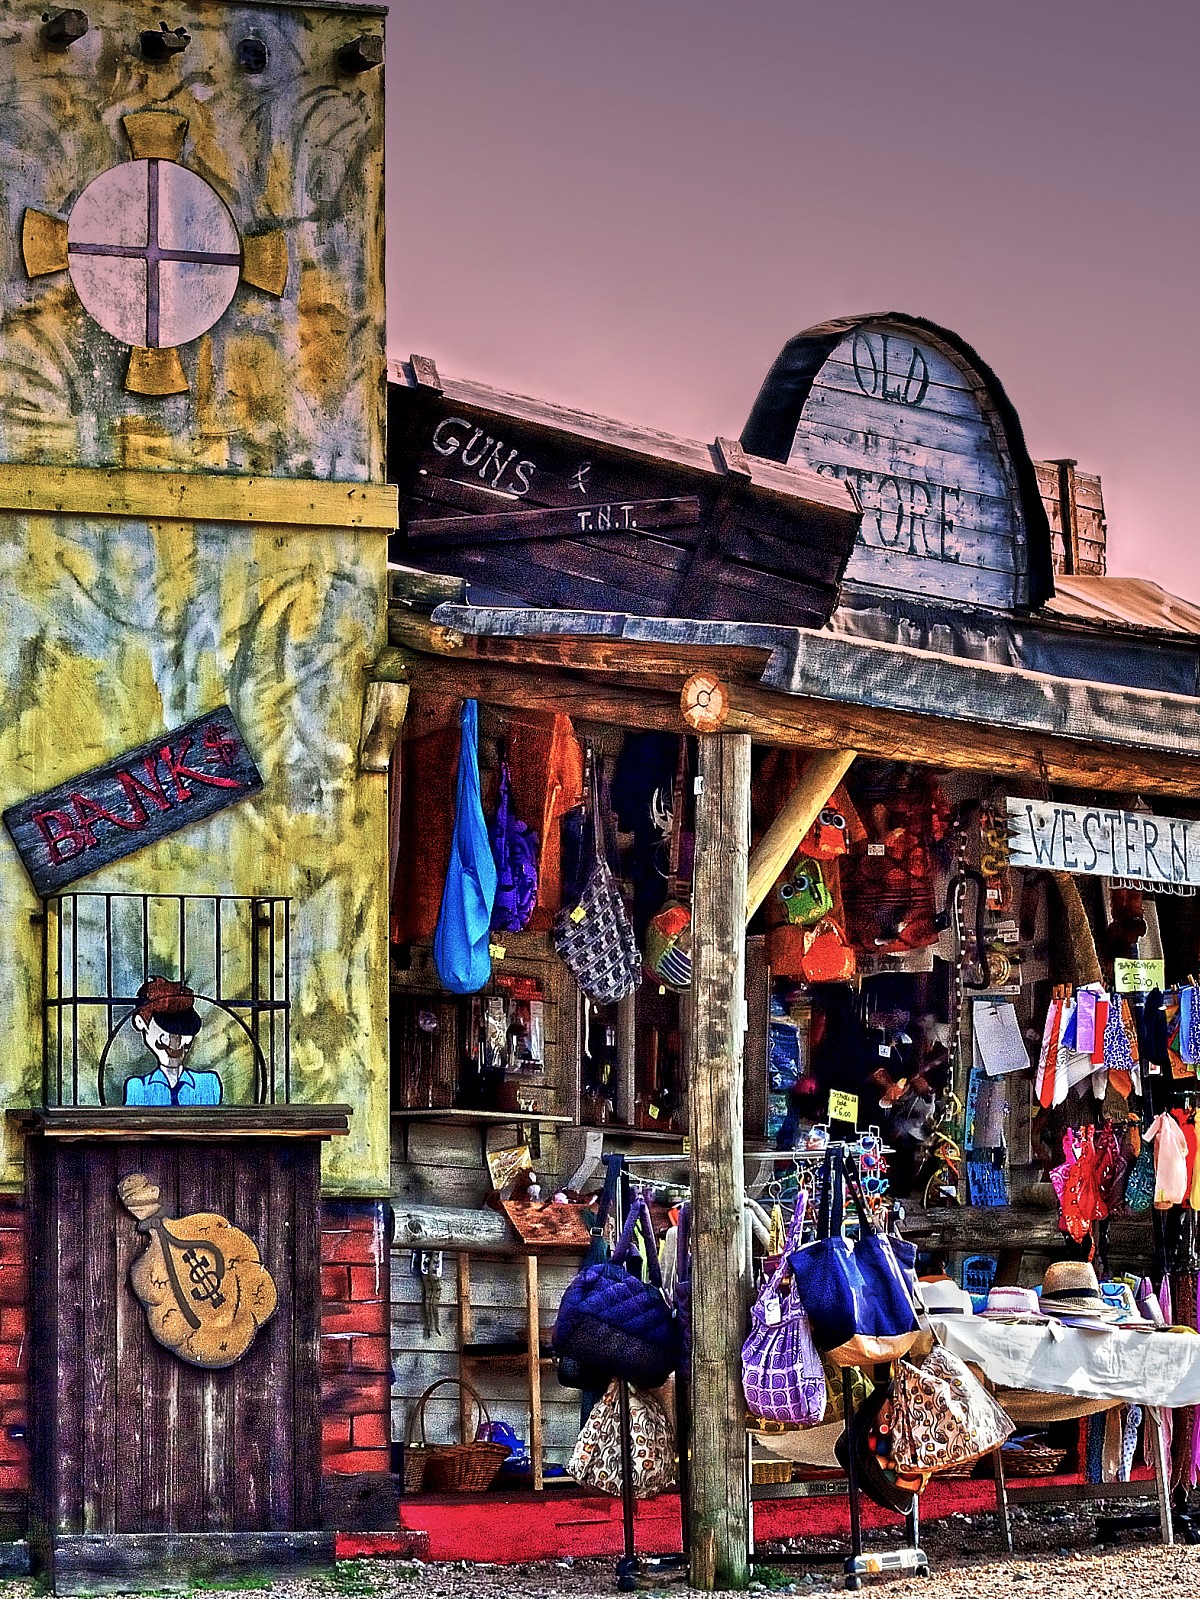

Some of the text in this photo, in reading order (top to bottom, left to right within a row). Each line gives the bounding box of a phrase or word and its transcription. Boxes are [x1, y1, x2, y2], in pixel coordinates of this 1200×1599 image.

[851, 329, 930, 405] OLD
[432, 416, 537, 495] GUNS
[817, 463, 961, 563] TORE
[1025, 804, 1190, 882] WESTERN
